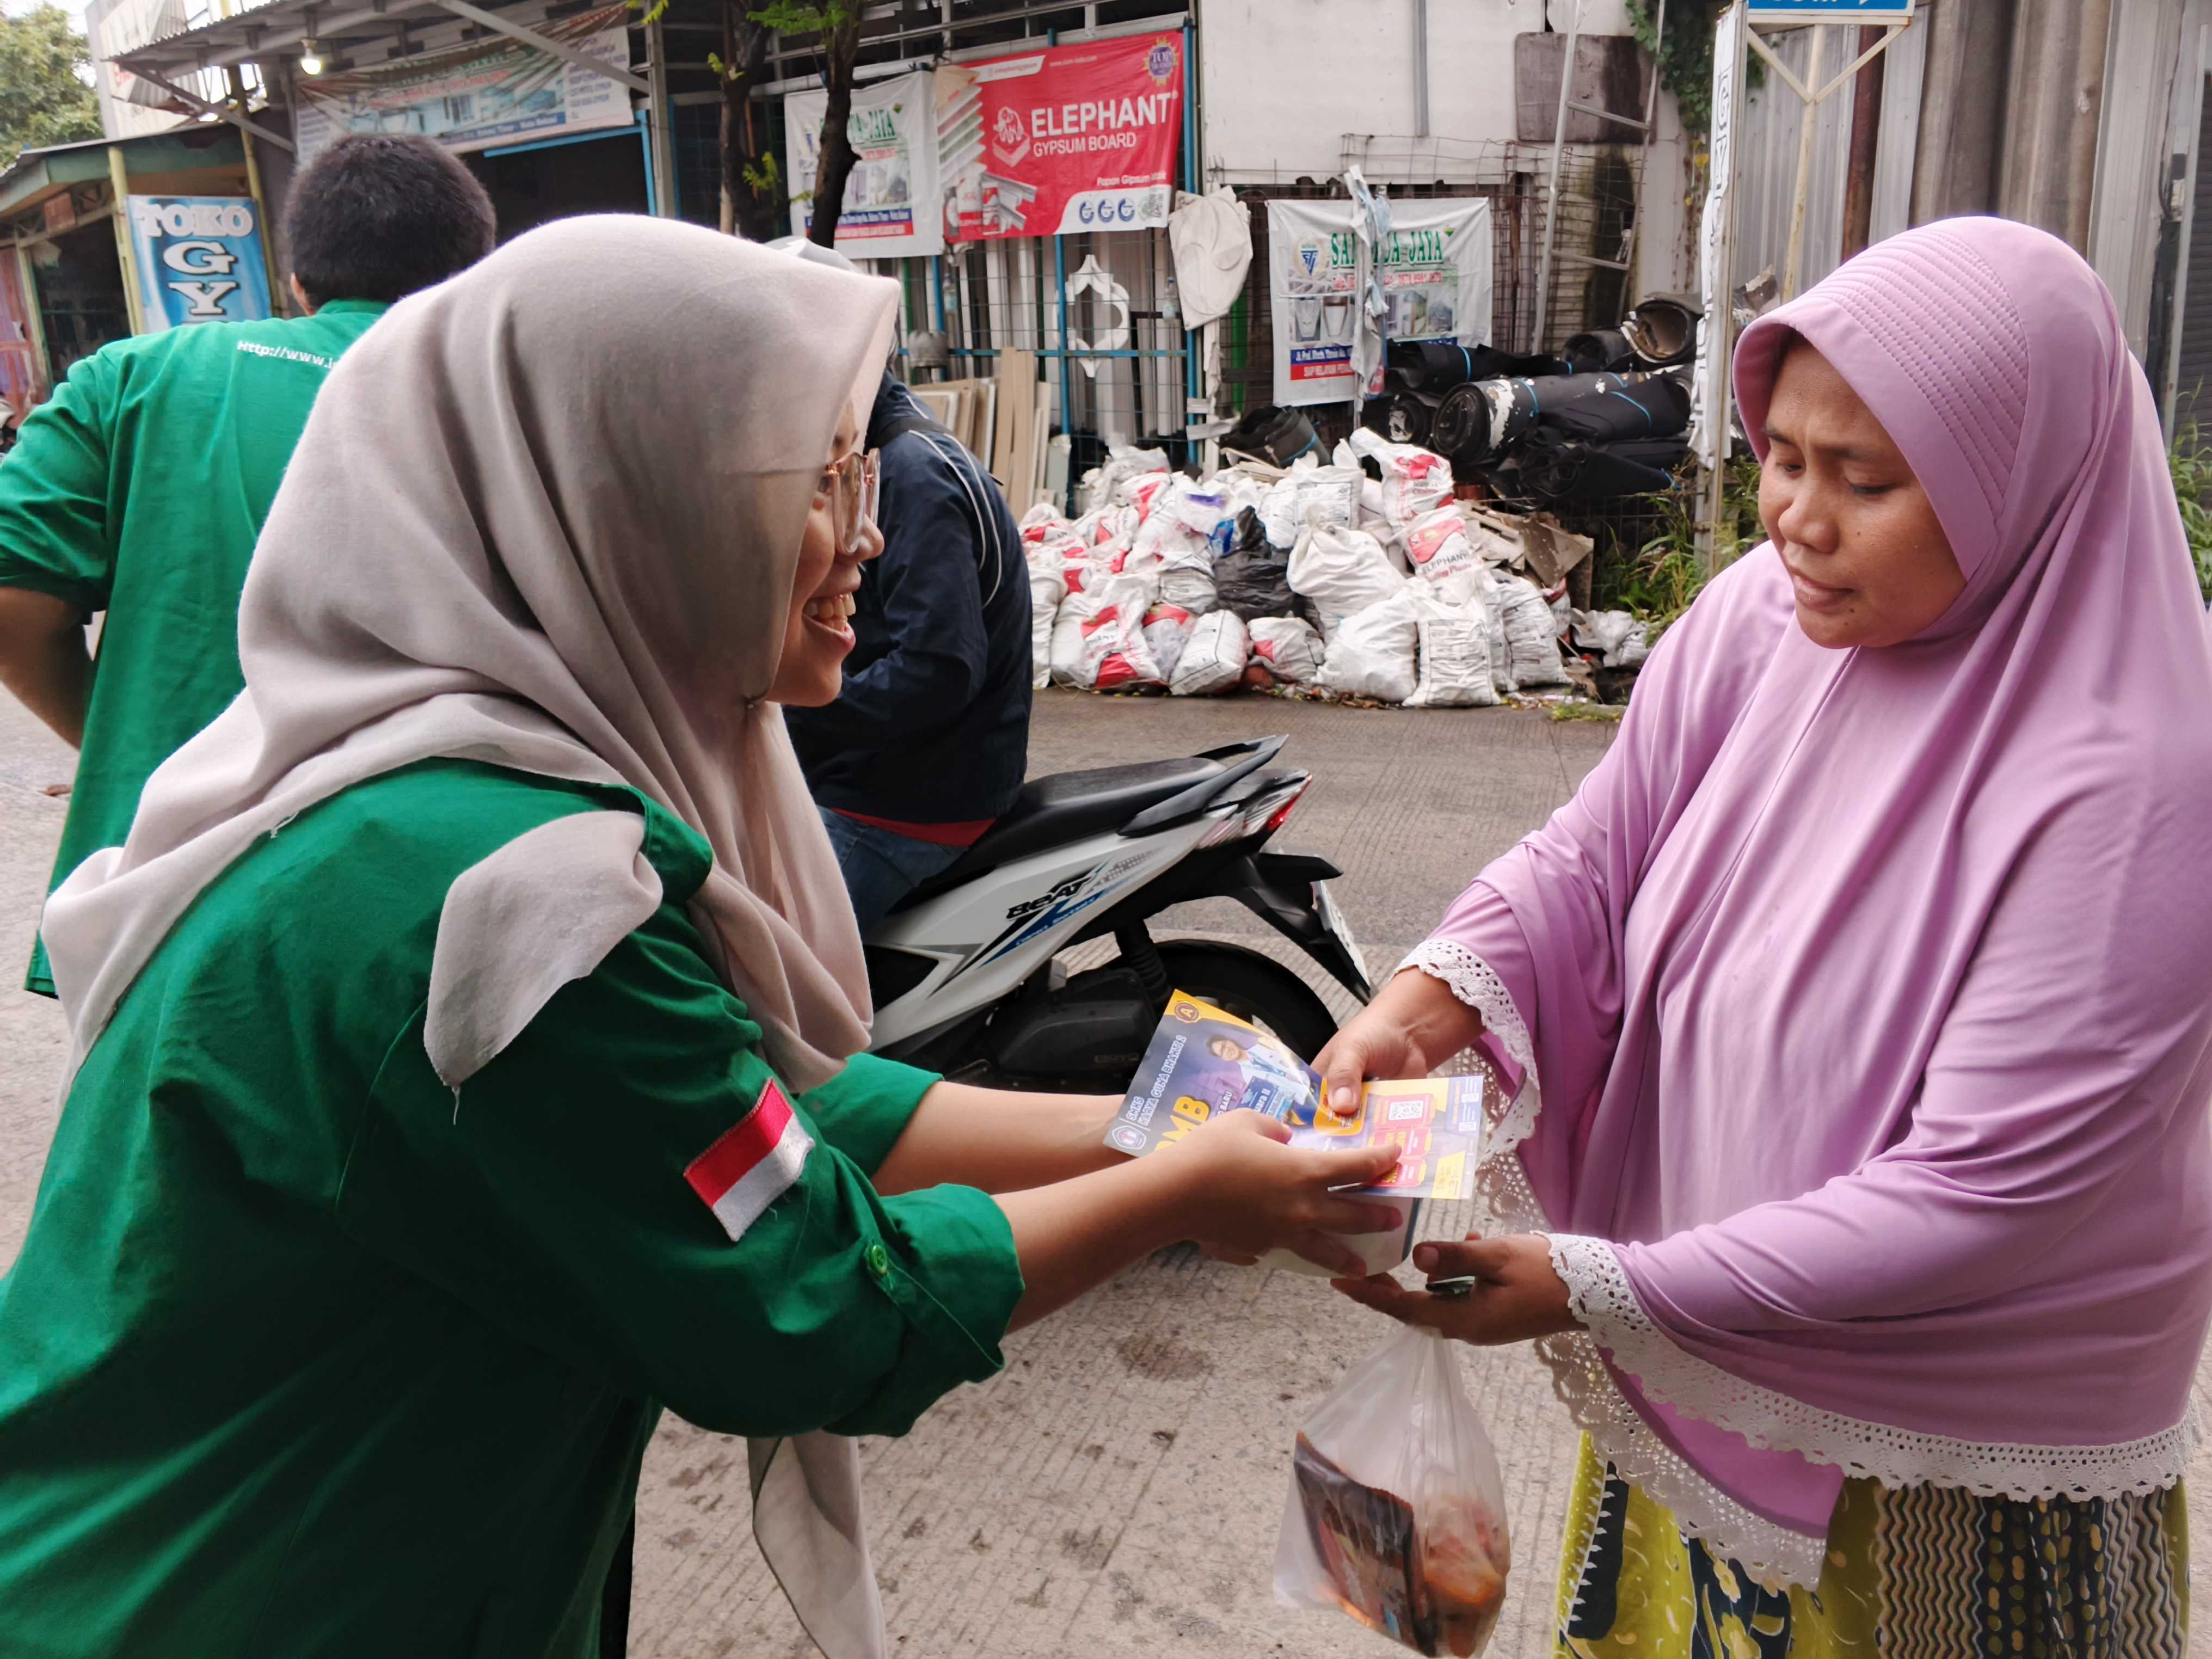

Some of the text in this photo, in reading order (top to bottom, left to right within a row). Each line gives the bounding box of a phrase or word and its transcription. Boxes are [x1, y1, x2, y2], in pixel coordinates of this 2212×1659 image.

[1031, 91, 1171, 138] ELEPHANT
[1034, 132, 1137, 157] GYPSUM BOARD
[136, 204, 254, 238] TOKO
[1408, 230, 1443, 262] JAYA
[1180, 1007, 1194, 1018] A
[1138, 1034, 1187, 1126] KARYA GUNA BHAKTI 2
[1125, 1096, 1145, 1121] SMKS
[1220, 1090, 1233, 1111] BARU
